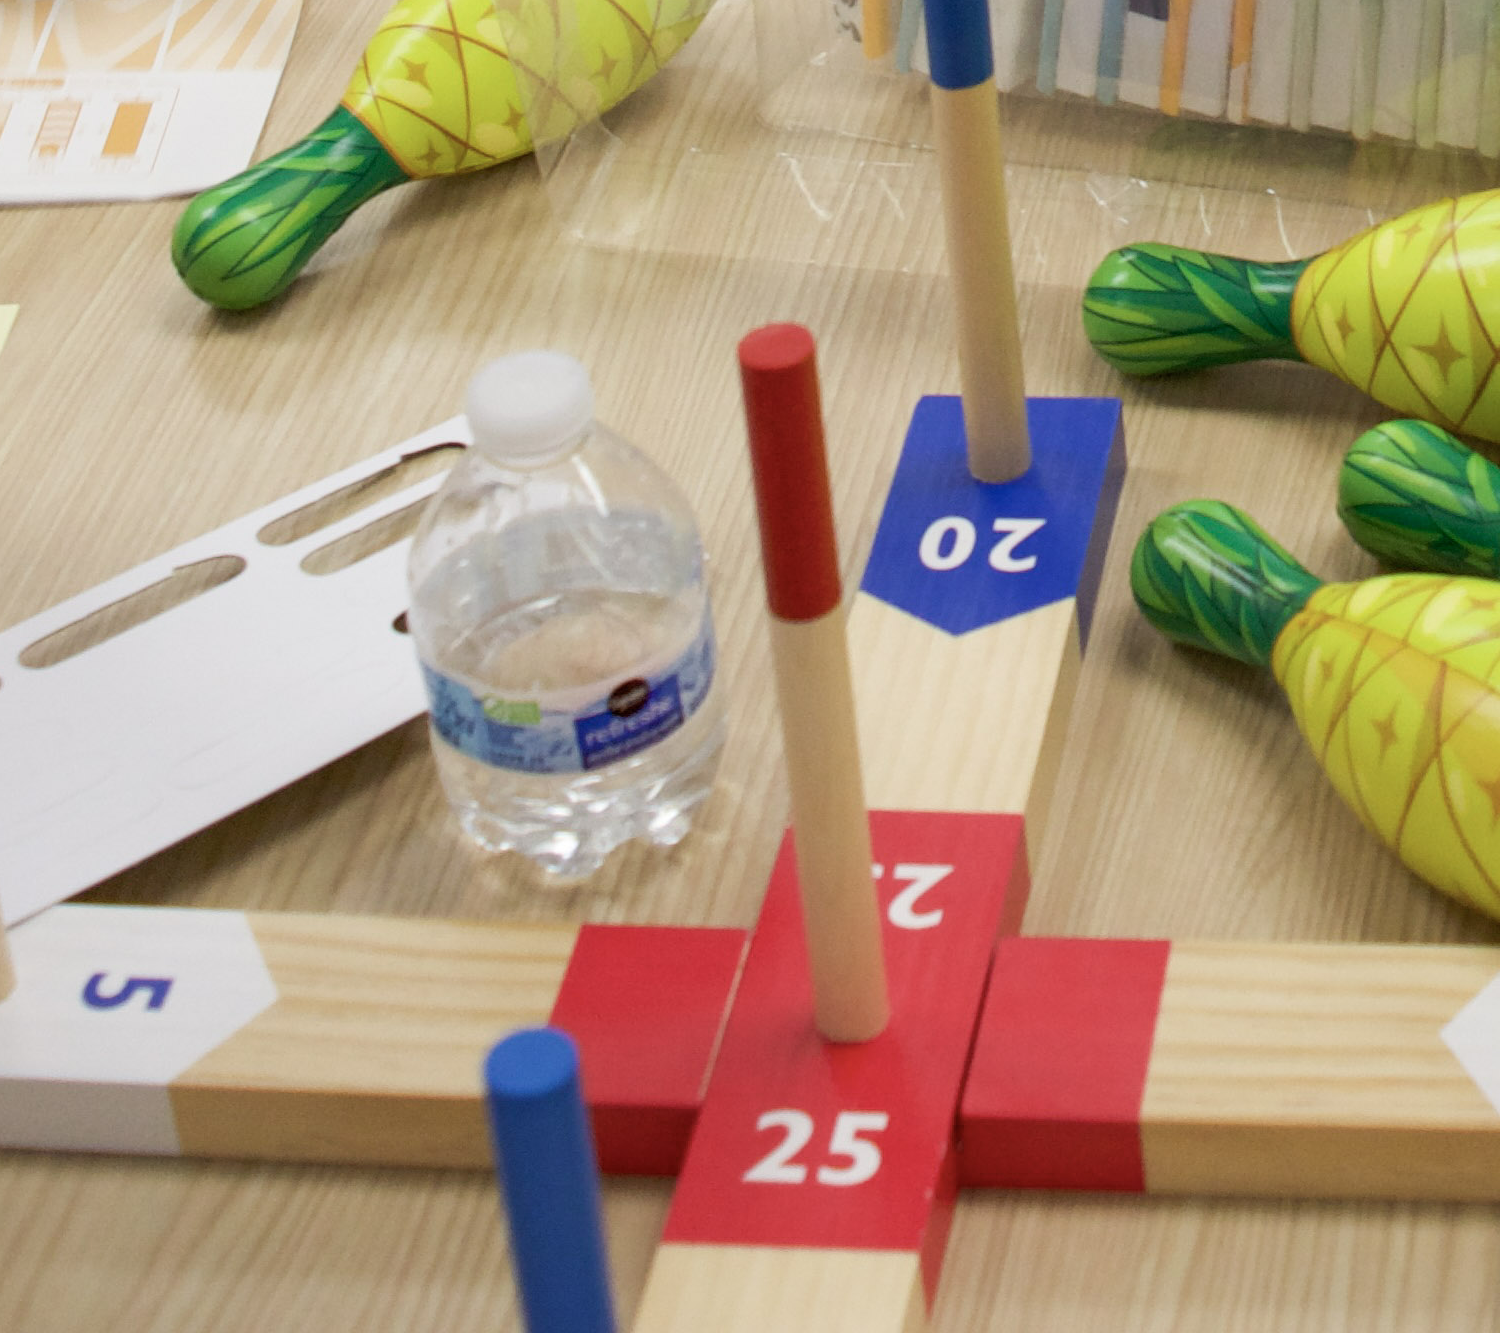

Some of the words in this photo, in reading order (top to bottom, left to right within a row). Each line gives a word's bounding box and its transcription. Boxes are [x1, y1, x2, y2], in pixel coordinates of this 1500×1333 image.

[917, 514, 1040, 572] 20
[871, 862, 947, 931] 2
[81, 970, 174, 1012] 5
[739, 1108, 890, 1187] 25
